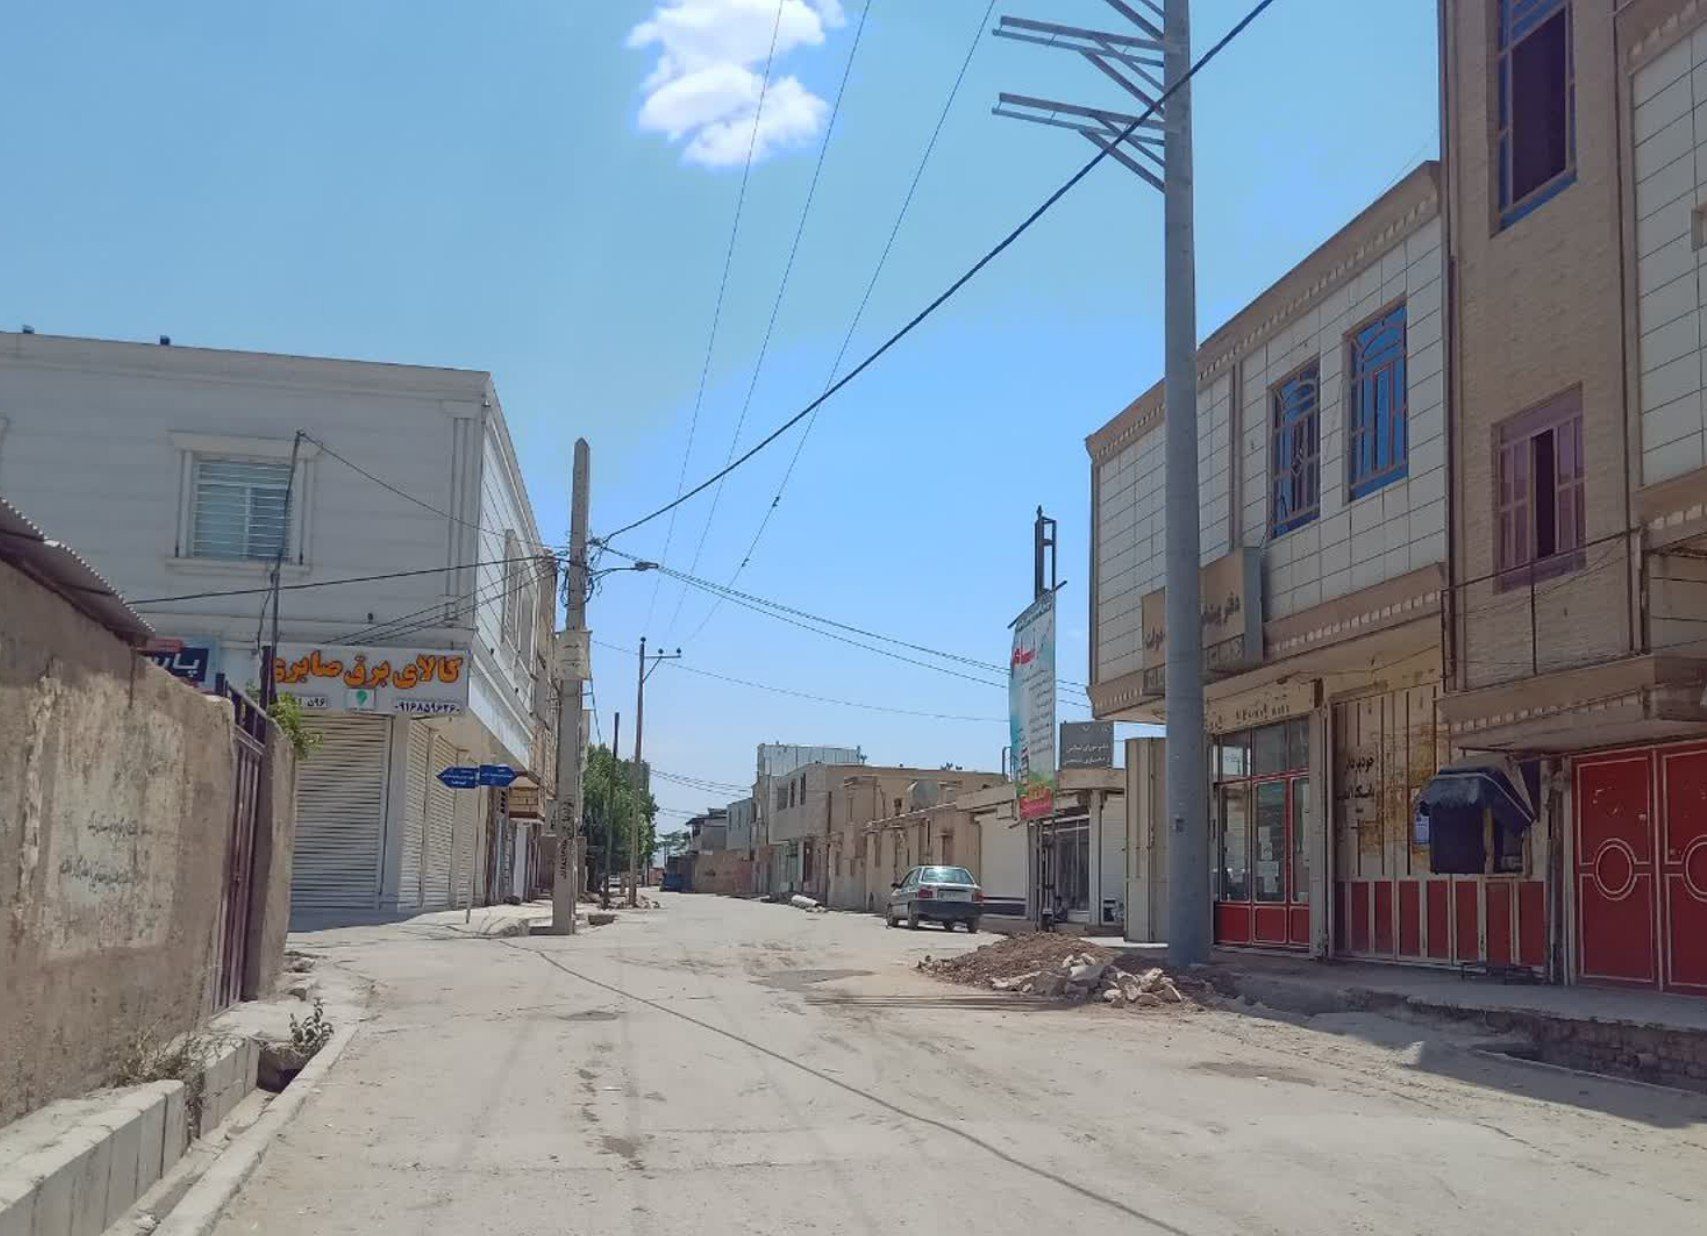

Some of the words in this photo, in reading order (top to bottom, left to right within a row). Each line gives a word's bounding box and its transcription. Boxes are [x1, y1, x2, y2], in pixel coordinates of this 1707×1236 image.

[273, 649, 343, 684] صابری
[344, 654, 390, 690] برق
[393, 653, 463, 689] کالای
